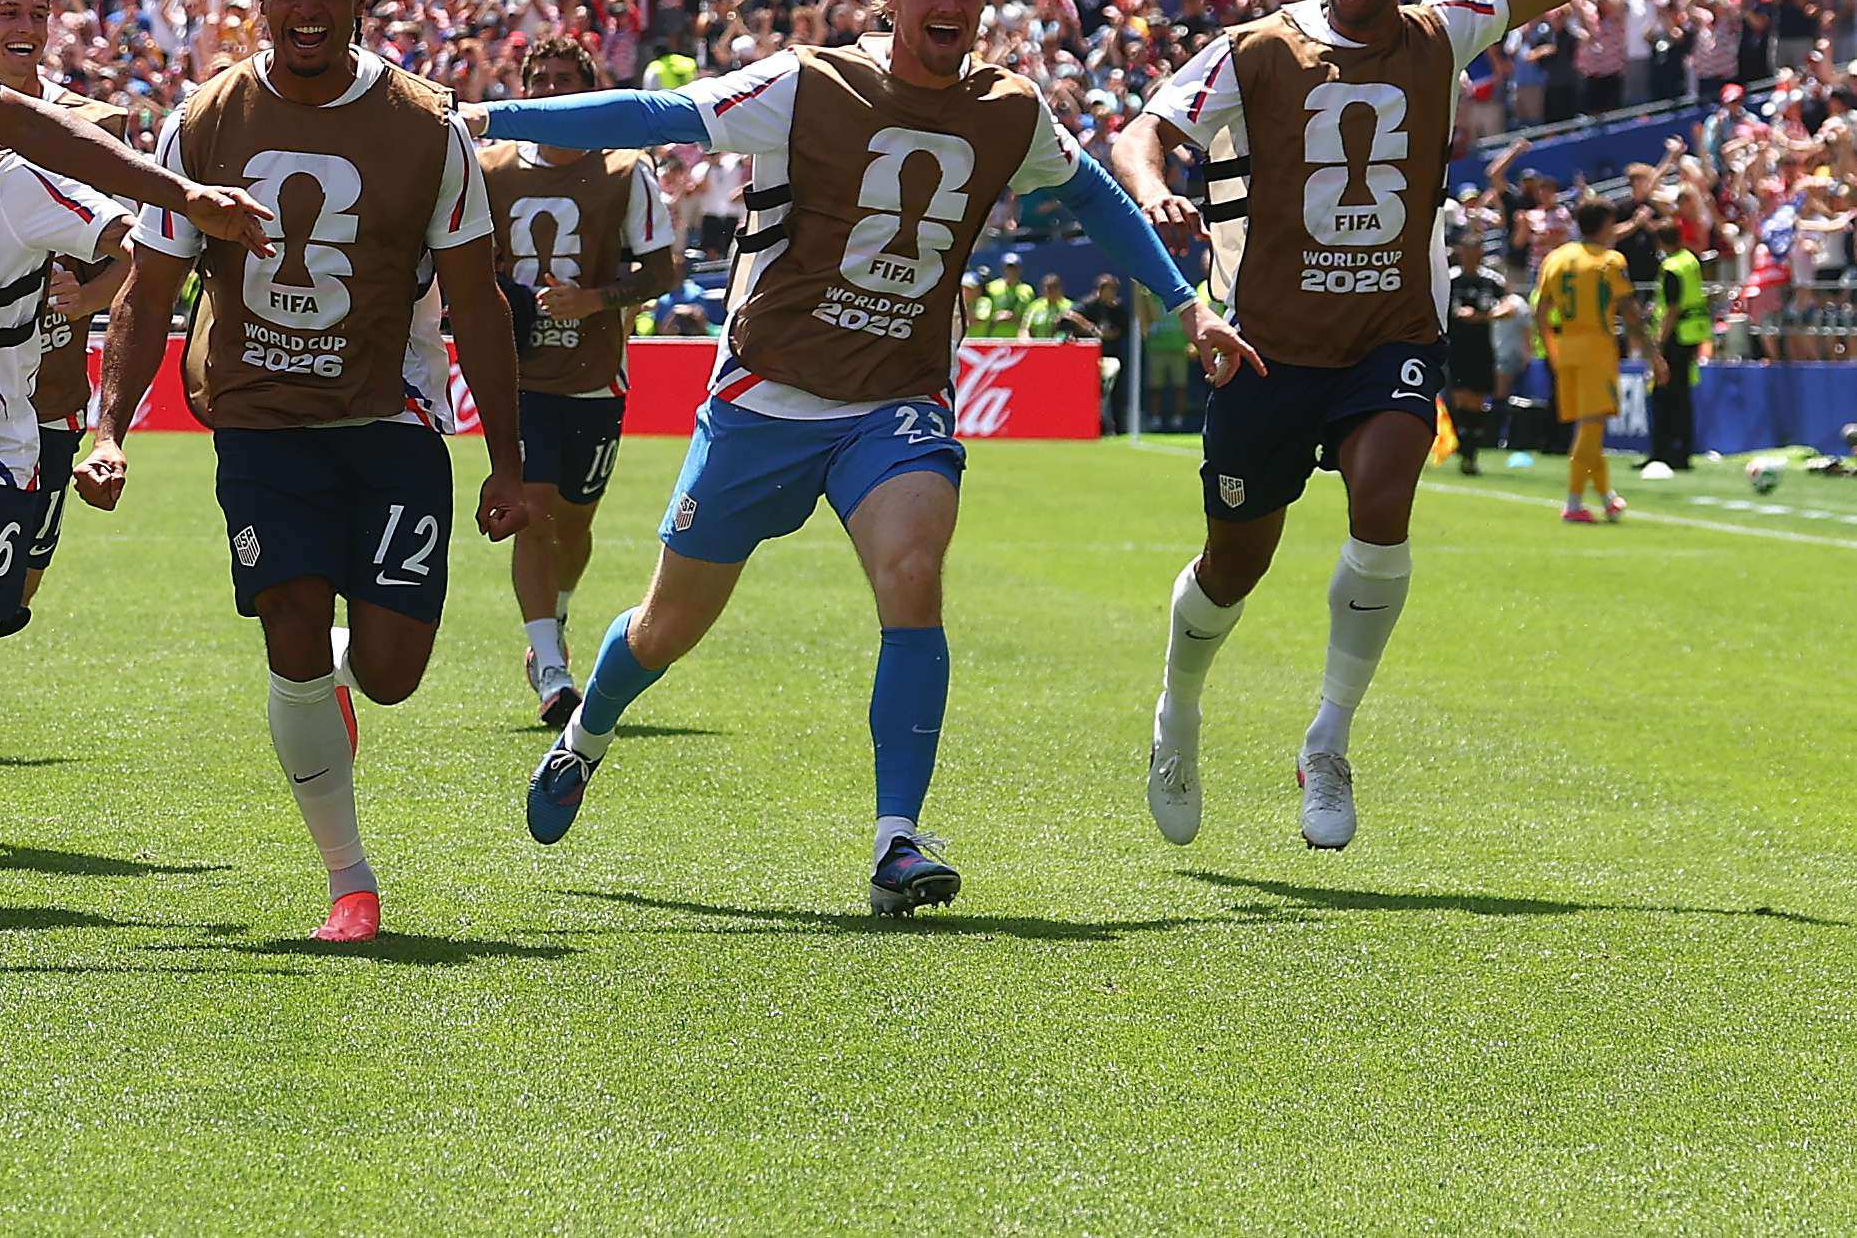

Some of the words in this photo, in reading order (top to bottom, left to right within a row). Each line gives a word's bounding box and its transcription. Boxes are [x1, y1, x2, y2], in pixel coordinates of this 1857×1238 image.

[1335, 214, 1382, 231] FIFA
[1303, 251, 1369, 266] WORLD
[1371, 251, 1403, 265] CUP
[869, 260, 916, 284] FIFA
[1301, 268, 1402, 293] 2026
[270, 291, 319, 313] FIFA
[825, 286, 891, 312] WORLD
[811, 302, 913, 339] 2026
[40, 324, 72, 353] 26
[243, 322, 304, 351] WORLD
[307, 336, 347, 351] CUP
[530, 330, 580, 348] 026
[242, 341, 343, 378] 2026
[1400, 358, 1427, 387] 6
[585, 440, 618, 482] 10
[1220, 476, 1242, 491] USA
[235, 527, 254, 548] USA
[373, 504, 439, 576] 12
